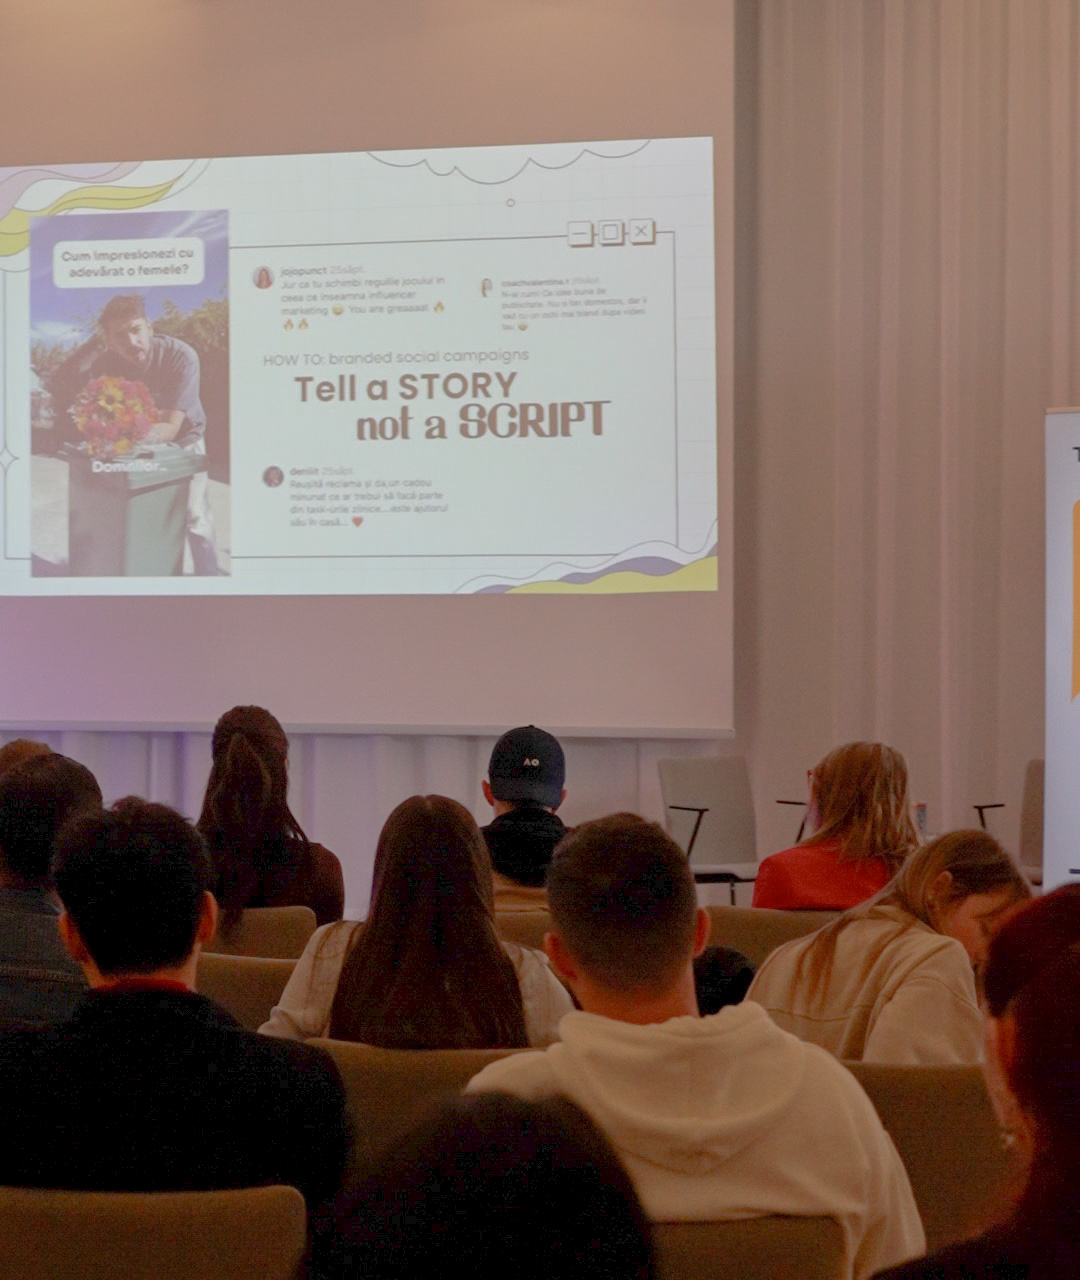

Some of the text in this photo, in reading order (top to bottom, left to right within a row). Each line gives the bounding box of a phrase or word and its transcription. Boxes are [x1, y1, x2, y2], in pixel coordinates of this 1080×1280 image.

[61, 247, 194, 263] Cum impresionezi cu
[69, 263, 189, 278] adevărat o femeie?
[279, 267, 327, 279] jojopunct
[325, 277, 362, 288] schimbi
[368, 289, 417, 300] influencer
[281, 306, 330, 317] marketing
[348, 304, 367, 314] You
[369, 305, 385, 314] are
[263, 348, 530, 366] HOW TO: branded social campaigns
[294, 371, 517, 402] Tell a STORY
[356, 399, 612, 441] not a SCRIPT
